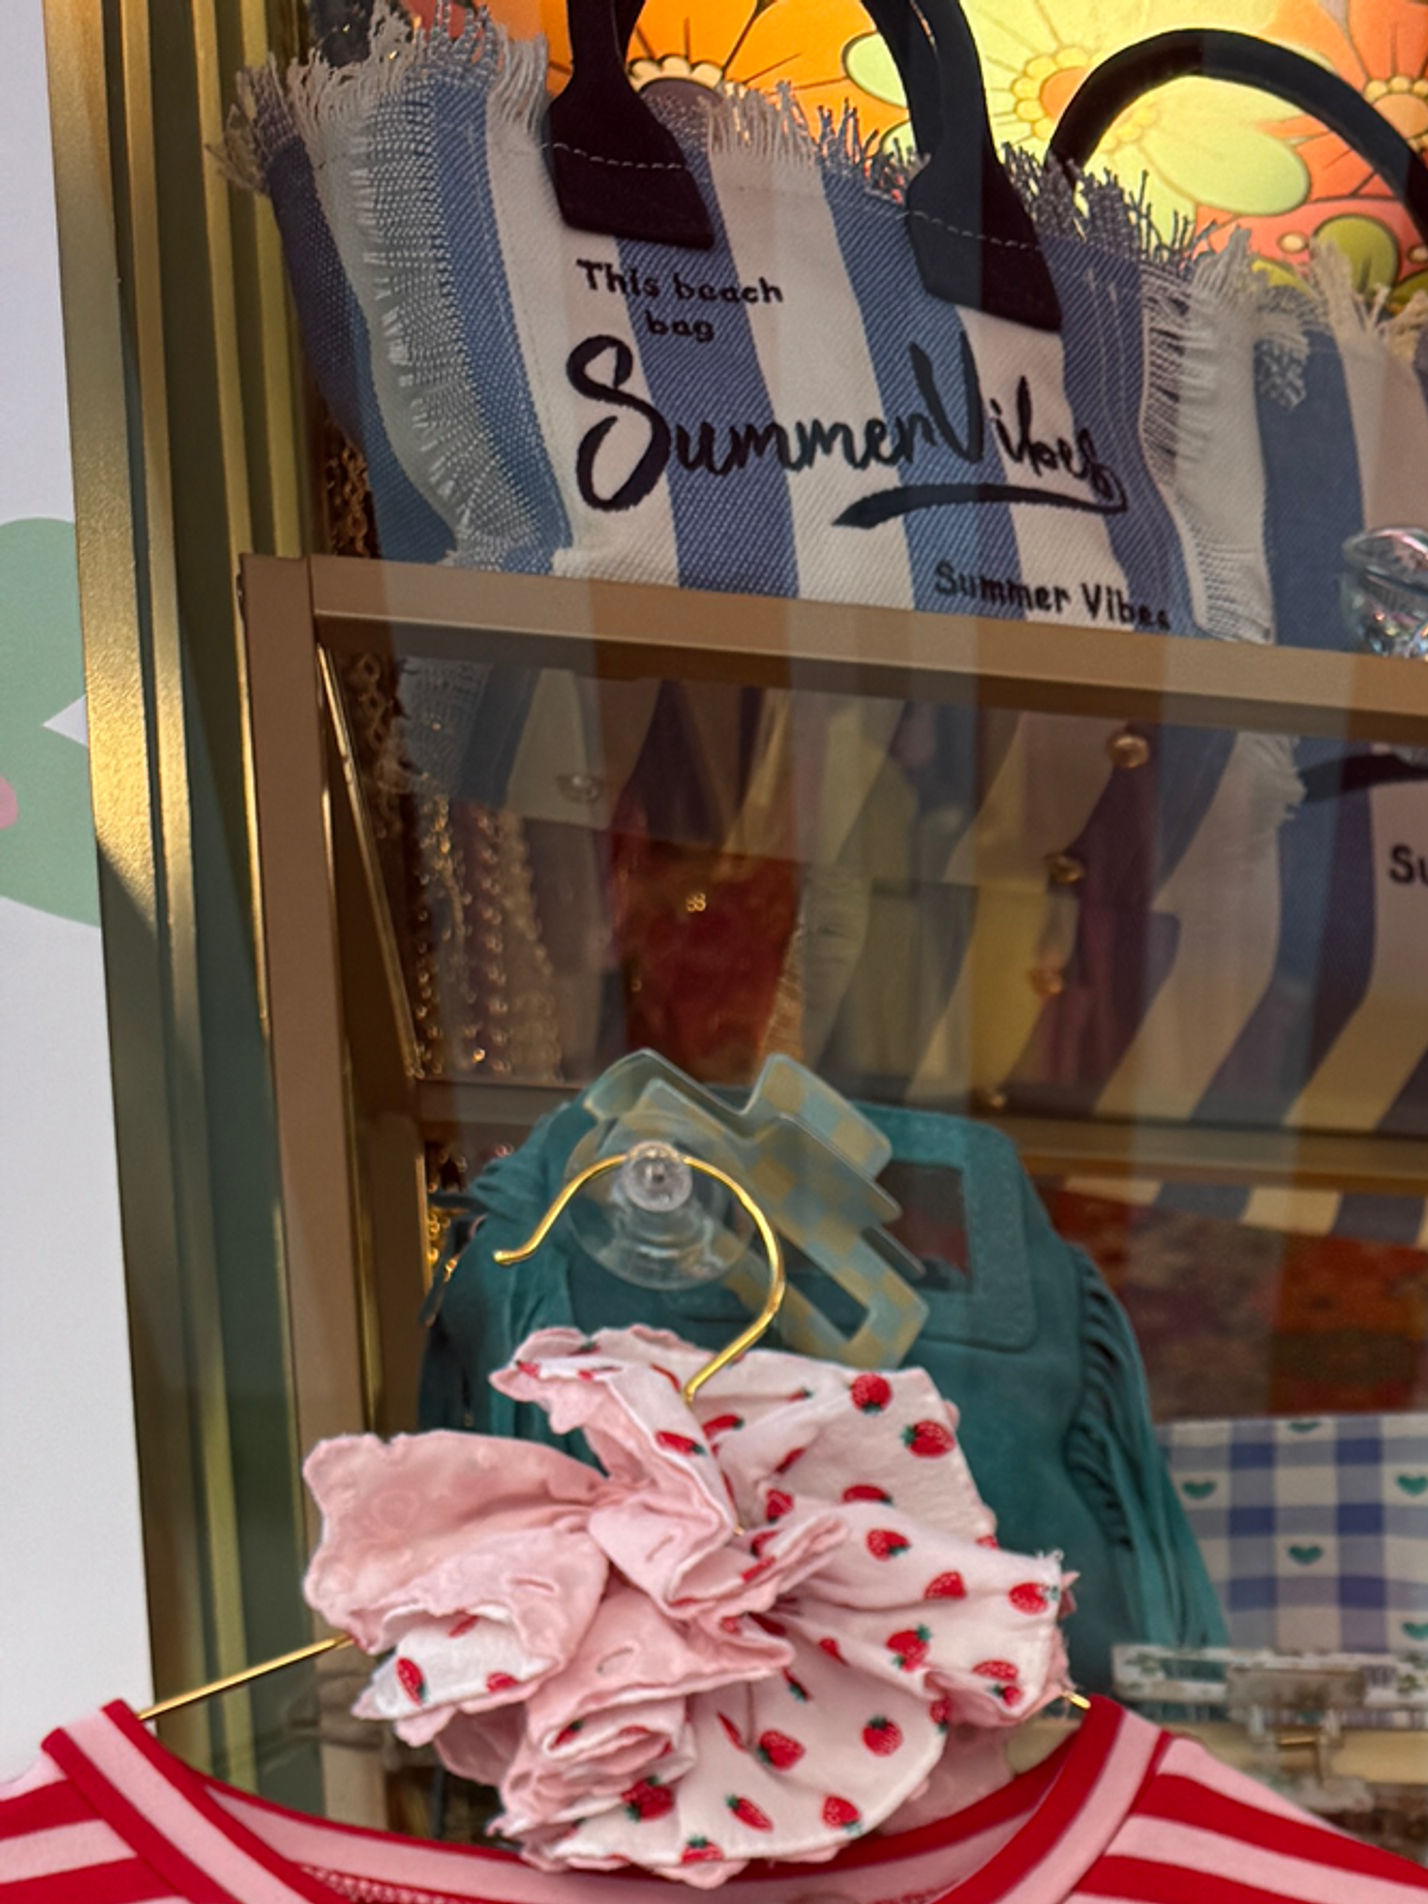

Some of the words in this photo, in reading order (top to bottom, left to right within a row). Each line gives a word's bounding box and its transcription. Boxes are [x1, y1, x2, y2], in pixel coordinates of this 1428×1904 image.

[576, 258, 662, 299] This
[672, 272, 783, 303] beach
[644, 309, 715, 342] bag
[566, 335, 936, 511] Summer
[934, 563, 1070, 612] Summer
[1080, 582, 1170, 633] Vibes
